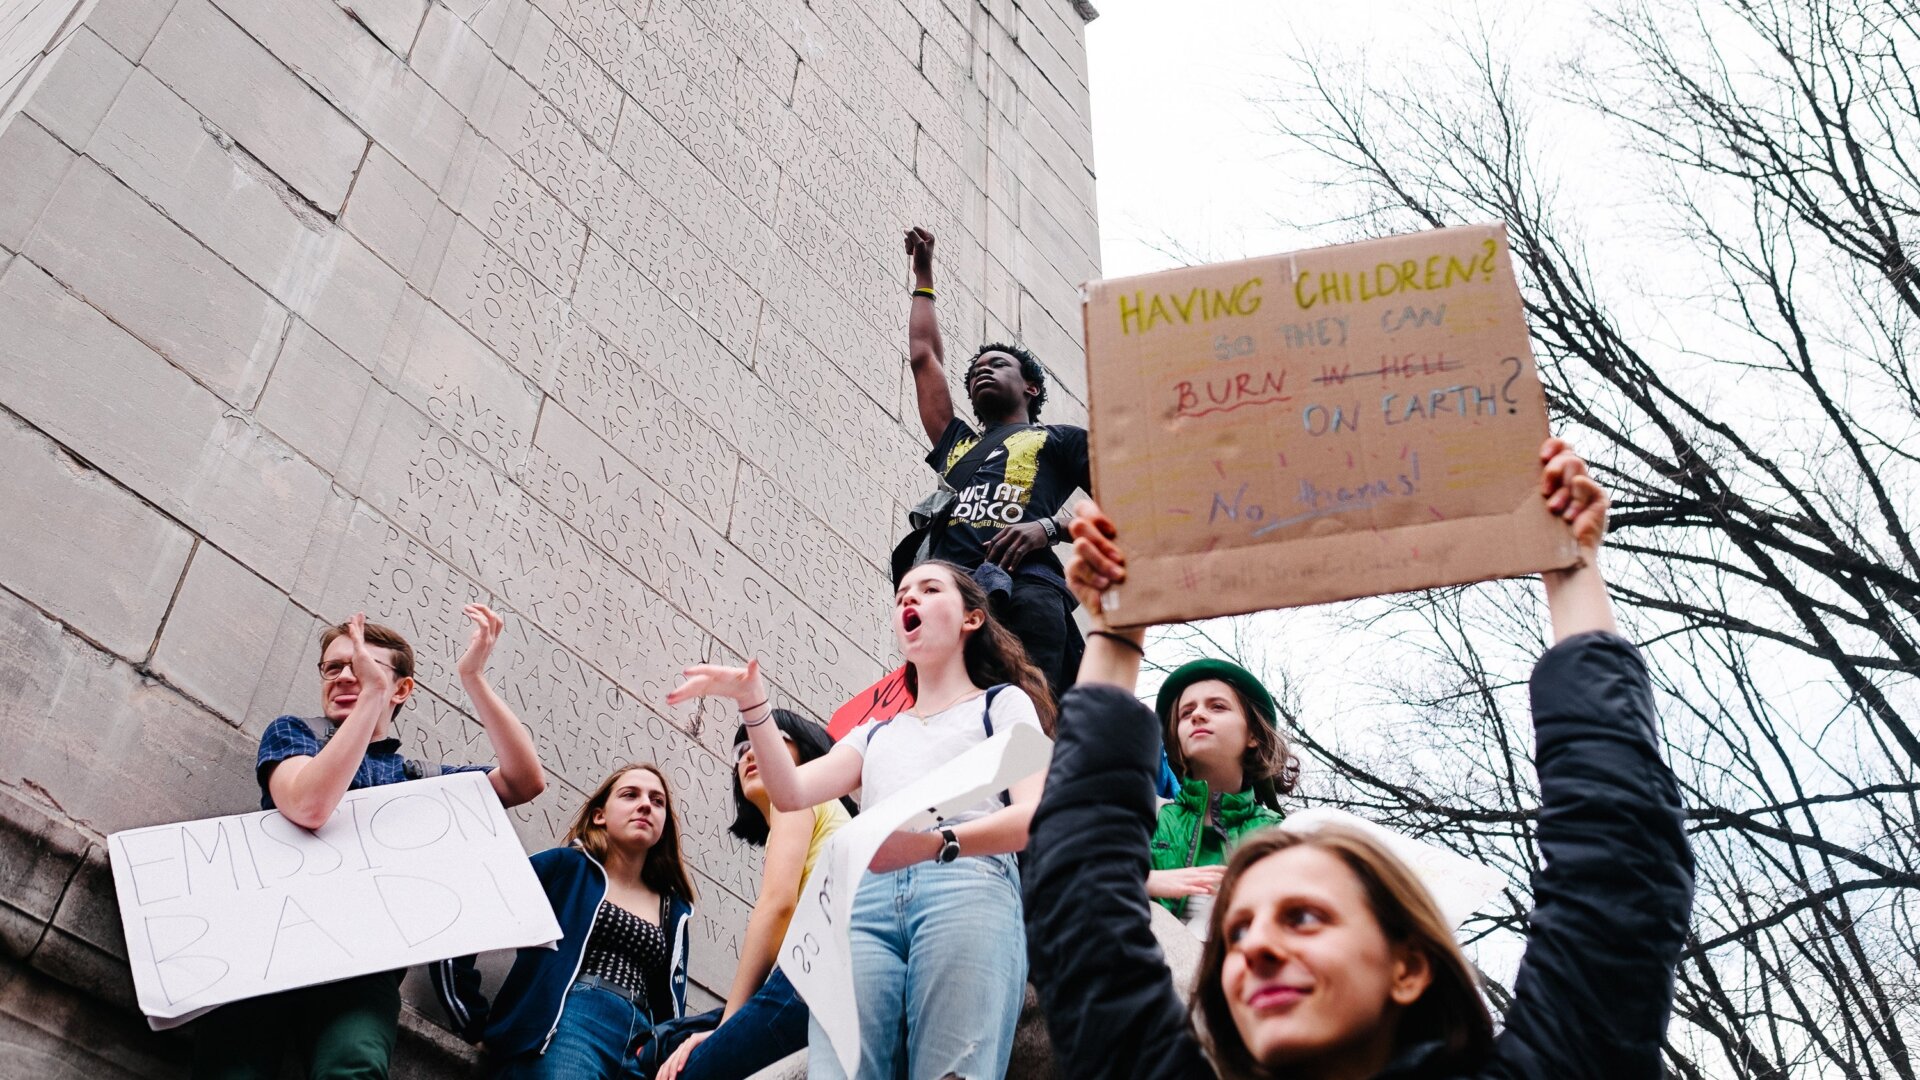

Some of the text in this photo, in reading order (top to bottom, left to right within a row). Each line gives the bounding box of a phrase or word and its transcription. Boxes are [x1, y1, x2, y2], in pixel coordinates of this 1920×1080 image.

[518, 124, 605, 214] PATRICK
[622, 217, 672, 274] SHEA
[524, 108, 635, 220] MICHAEL
[529, 90, 593, 159] JOHN
[616, 169, 673, 233] SHEA
[479, 238, 576, 331] THOMAS
[582, 324, 639, 386] TROY
[1119, 238, 1498, 336] HAVING CHILDREN?
[1215, 303, 1447, 360] SO THEY CAN
[465, 279, 547, 359] JOHN
[749, 512, 838, 602] GEORGE
[472, 258, 541, 328] JOHN
[545, 318, 642, 412] WARREN
[652, 406, 728, 485] ROBERT
[1173, 369, 1288, 413] BURN
[1380, 352, 1456, 382] HELL
[1302, 357, 1524, 438] ON EARTH?
[418, 419, 505, 499] JOHN
[433, 369, 796, 667] JAMES THOMAS BROWN JAMES
[458, 301, 589, 421] ALBERT
[736, 526, 807, 600] JOHN
[954, 500, 1024, 523] DISCO
[993, 482, 1025, 502] AT
[391, 496, 515, 601] FRANK
[526, 593, 630, 685] KELLY
[400, 470, 650, 669] WILLIAM JOSEPH
[409, 444, 687, 668] JOHN HENRY DIERKING
[562, 498, 695, 615] BROSNAN
[594, 455, 839, 670] MARINE GVARD
[369, 552, 472, 640] JOSEP
[510, 649, 635, 755] PATRICK
[633, 704, 715, 780] LOSKO
[118, 778, 497, 906] EMISSION
